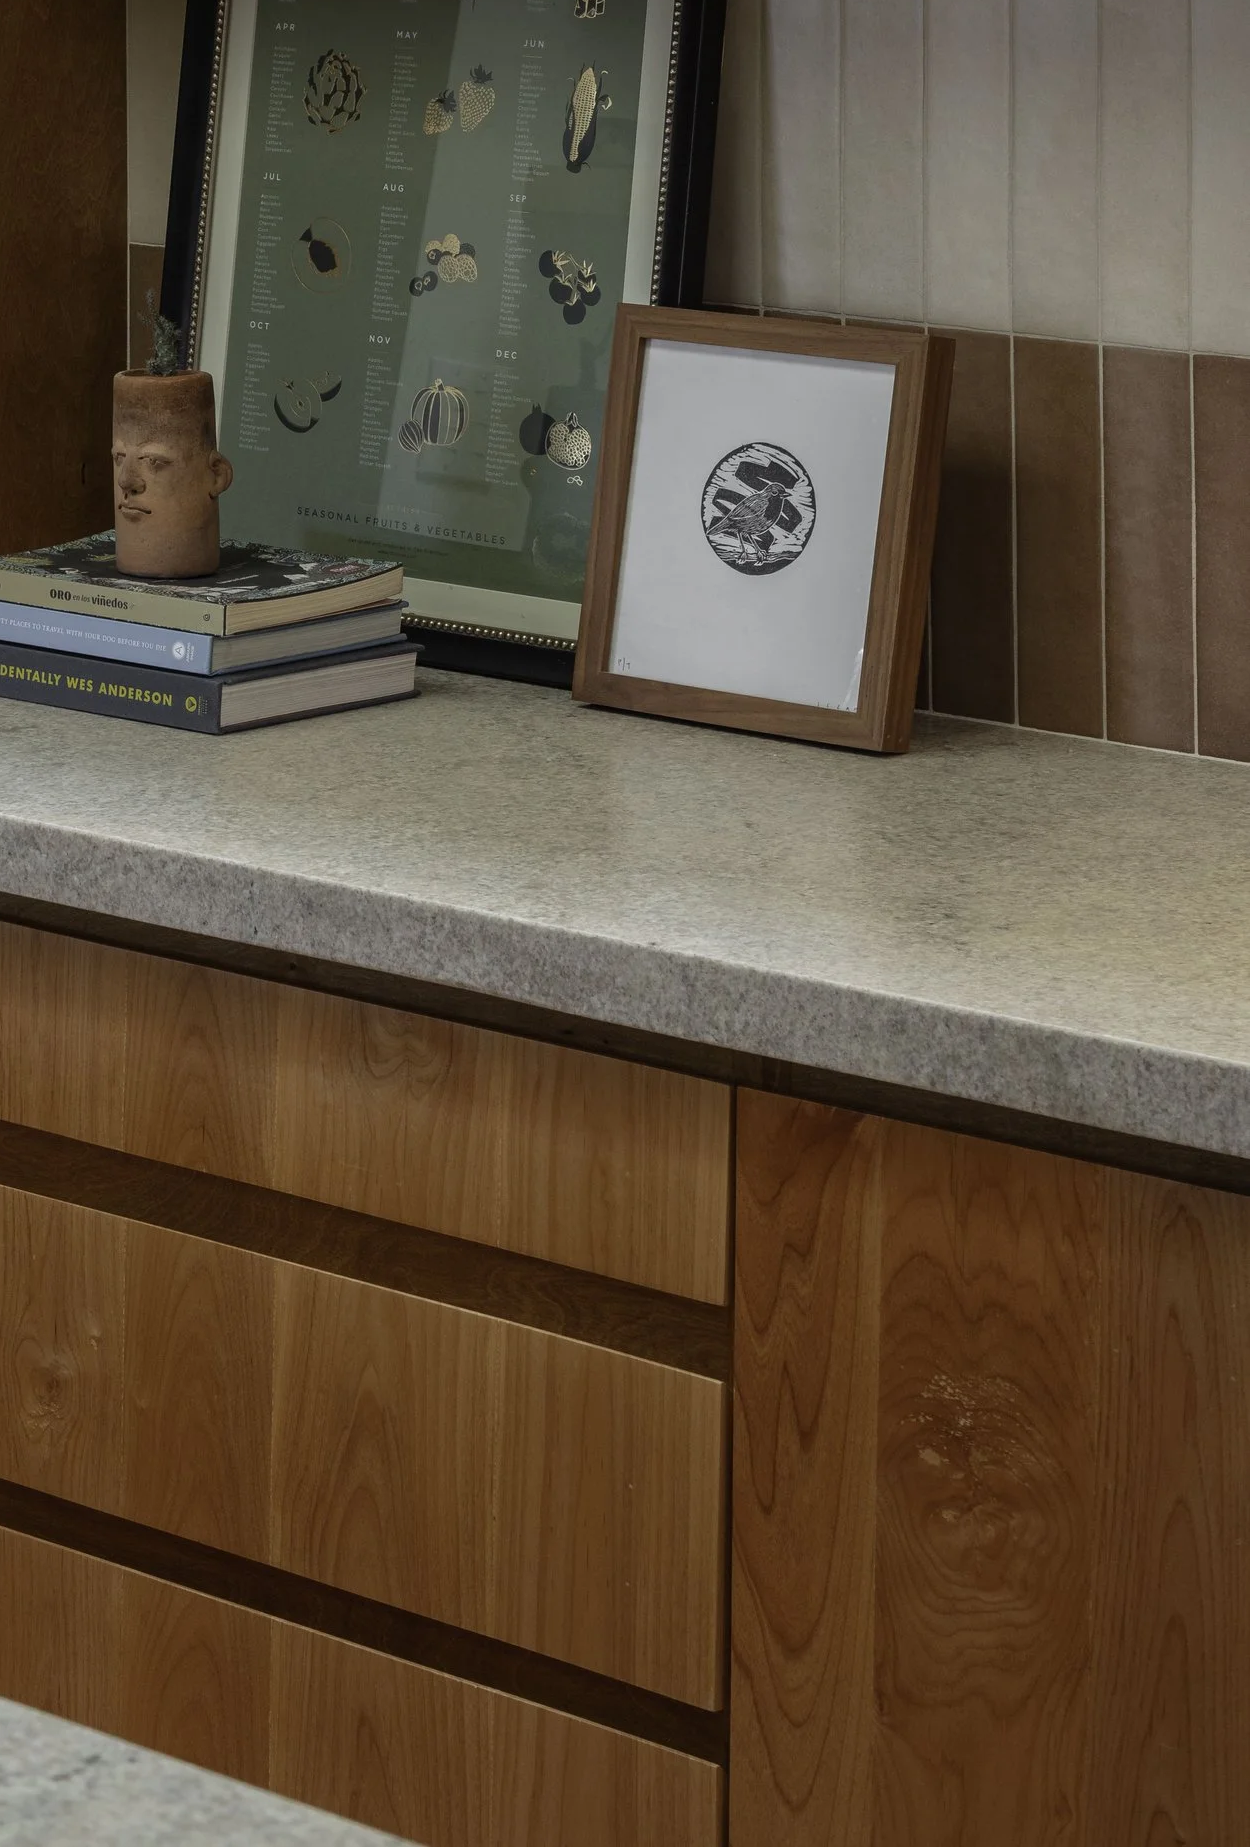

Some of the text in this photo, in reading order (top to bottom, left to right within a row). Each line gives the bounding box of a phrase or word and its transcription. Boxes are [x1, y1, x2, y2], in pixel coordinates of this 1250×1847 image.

[276, 23, 295, 31] APR
[524, 40, 544, 48] JUN
[383, 184, 403, 192] AUG
[510, 194, 526, 202] SEP
[250, 321, 269, 329] OCT
[369, 335, 390, 344] NOV
[496, 350, 517, 359] DEC
[297, 506, 506, 545] SEASONAL FRUITS & VEGETABLES
[49, 588, 72, 601] ORO
[81, 594, 90, 603] los
[91, 594, 128, 610] viñedos
[9, 619, 31, 628] PLACES
[32, 622, 41, 631] TO
[42, 624, 64, 634] TRAVEL
[66, 628, 83, 637] WITH
[85, 631, 101, 641] YOUR
[102, 634, 116, 643] DOG
[117, 637, 140, 647] BEFORE
[141, 641, 154, 649] YOU
[155, 644, 167, 652] DIE
[66, 675, 94, 692] WES
[98, 682, 173, 707] ANDERSON
